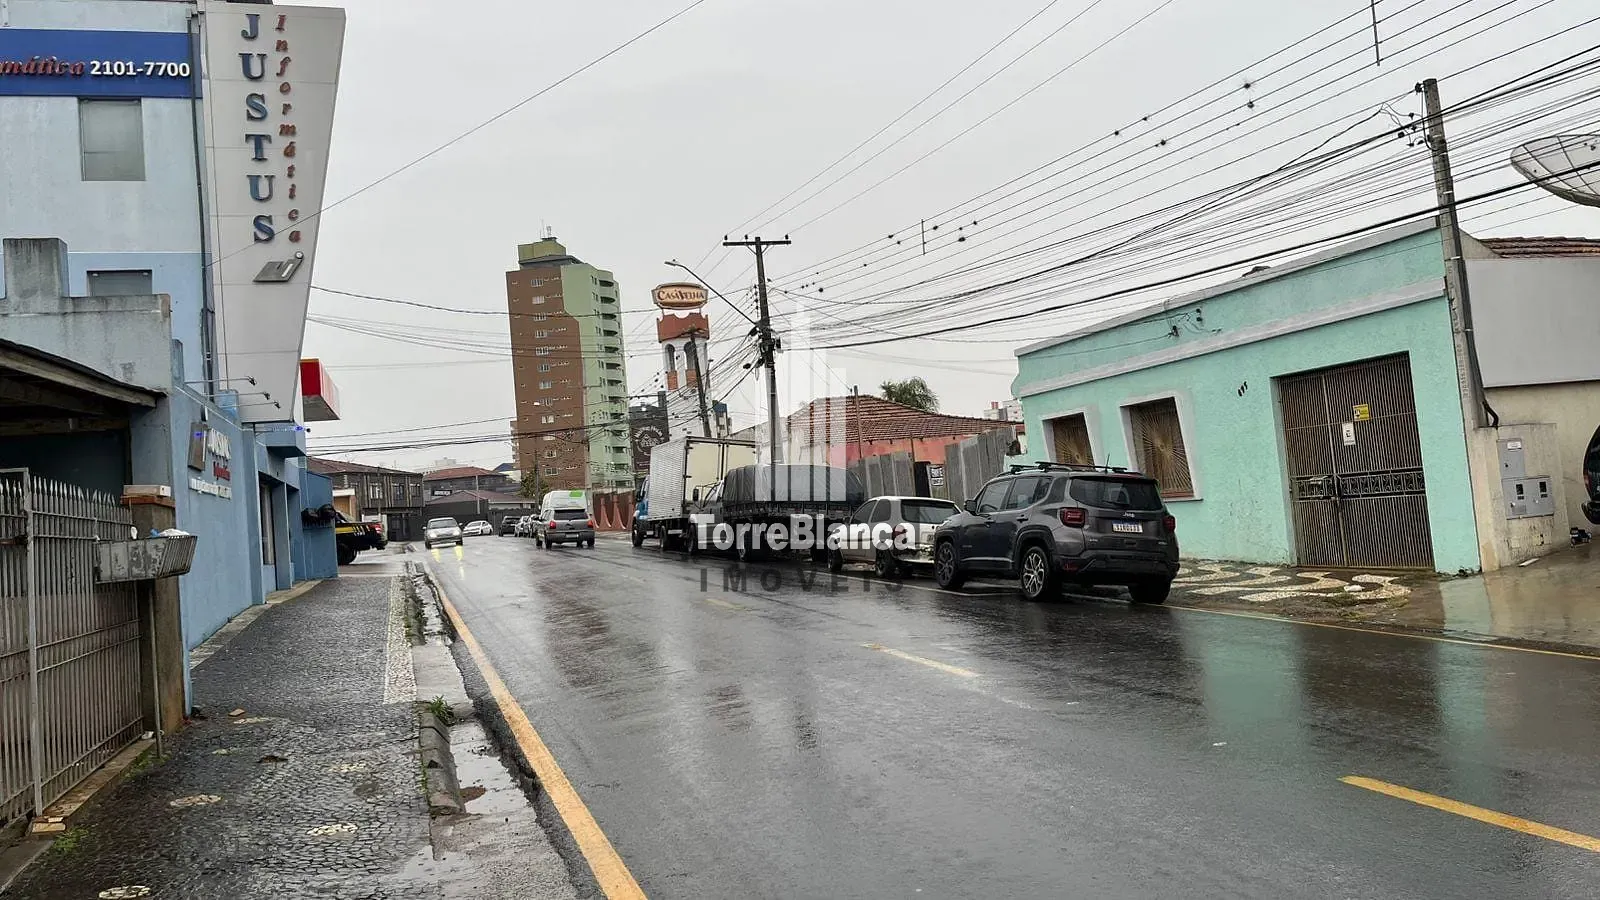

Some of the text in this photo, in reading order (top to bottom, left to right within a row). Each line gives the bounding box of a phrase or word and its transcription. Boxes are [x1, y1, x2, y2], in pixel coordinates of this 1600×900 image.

[90, 60, 191, 78] 2101-7700
[238, 13, 276, 244] JUSTUS
[275, 14, 302, 243] Informática
